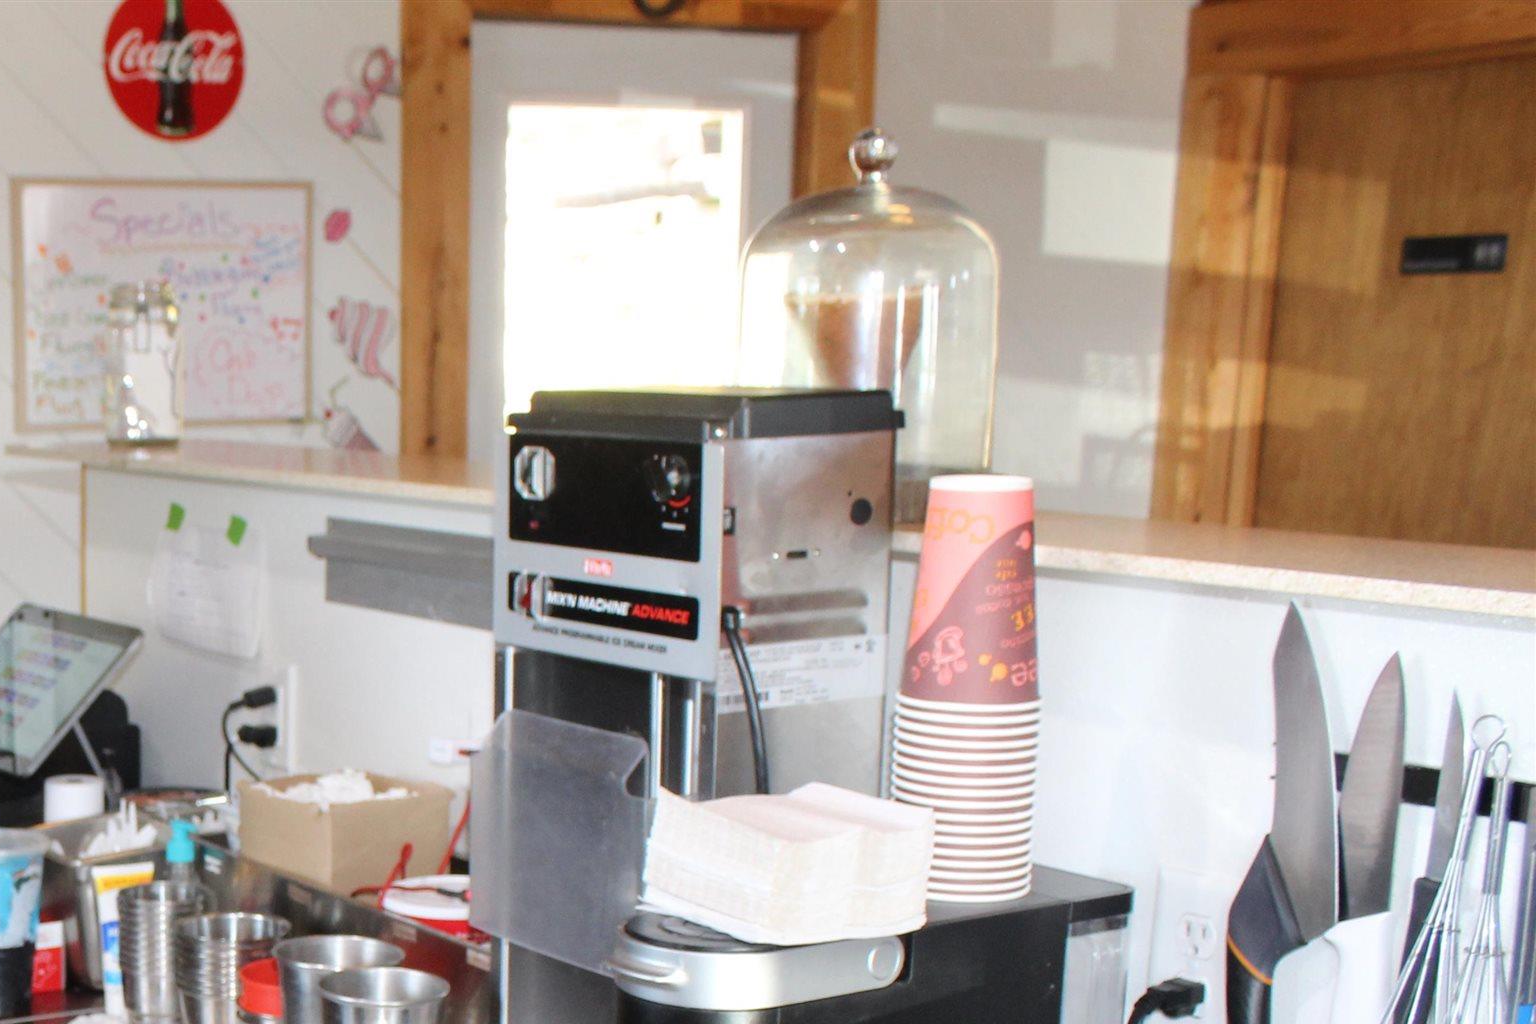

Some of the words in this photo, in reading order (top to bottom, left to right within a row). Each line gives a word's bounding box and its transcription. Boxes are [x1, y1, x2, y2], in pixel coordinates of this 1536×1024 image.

[89, 198, 242, 245] Specials
[577, 592, 632, 617] MACHINE
[632, 603, 691, 625] ADVANCE
